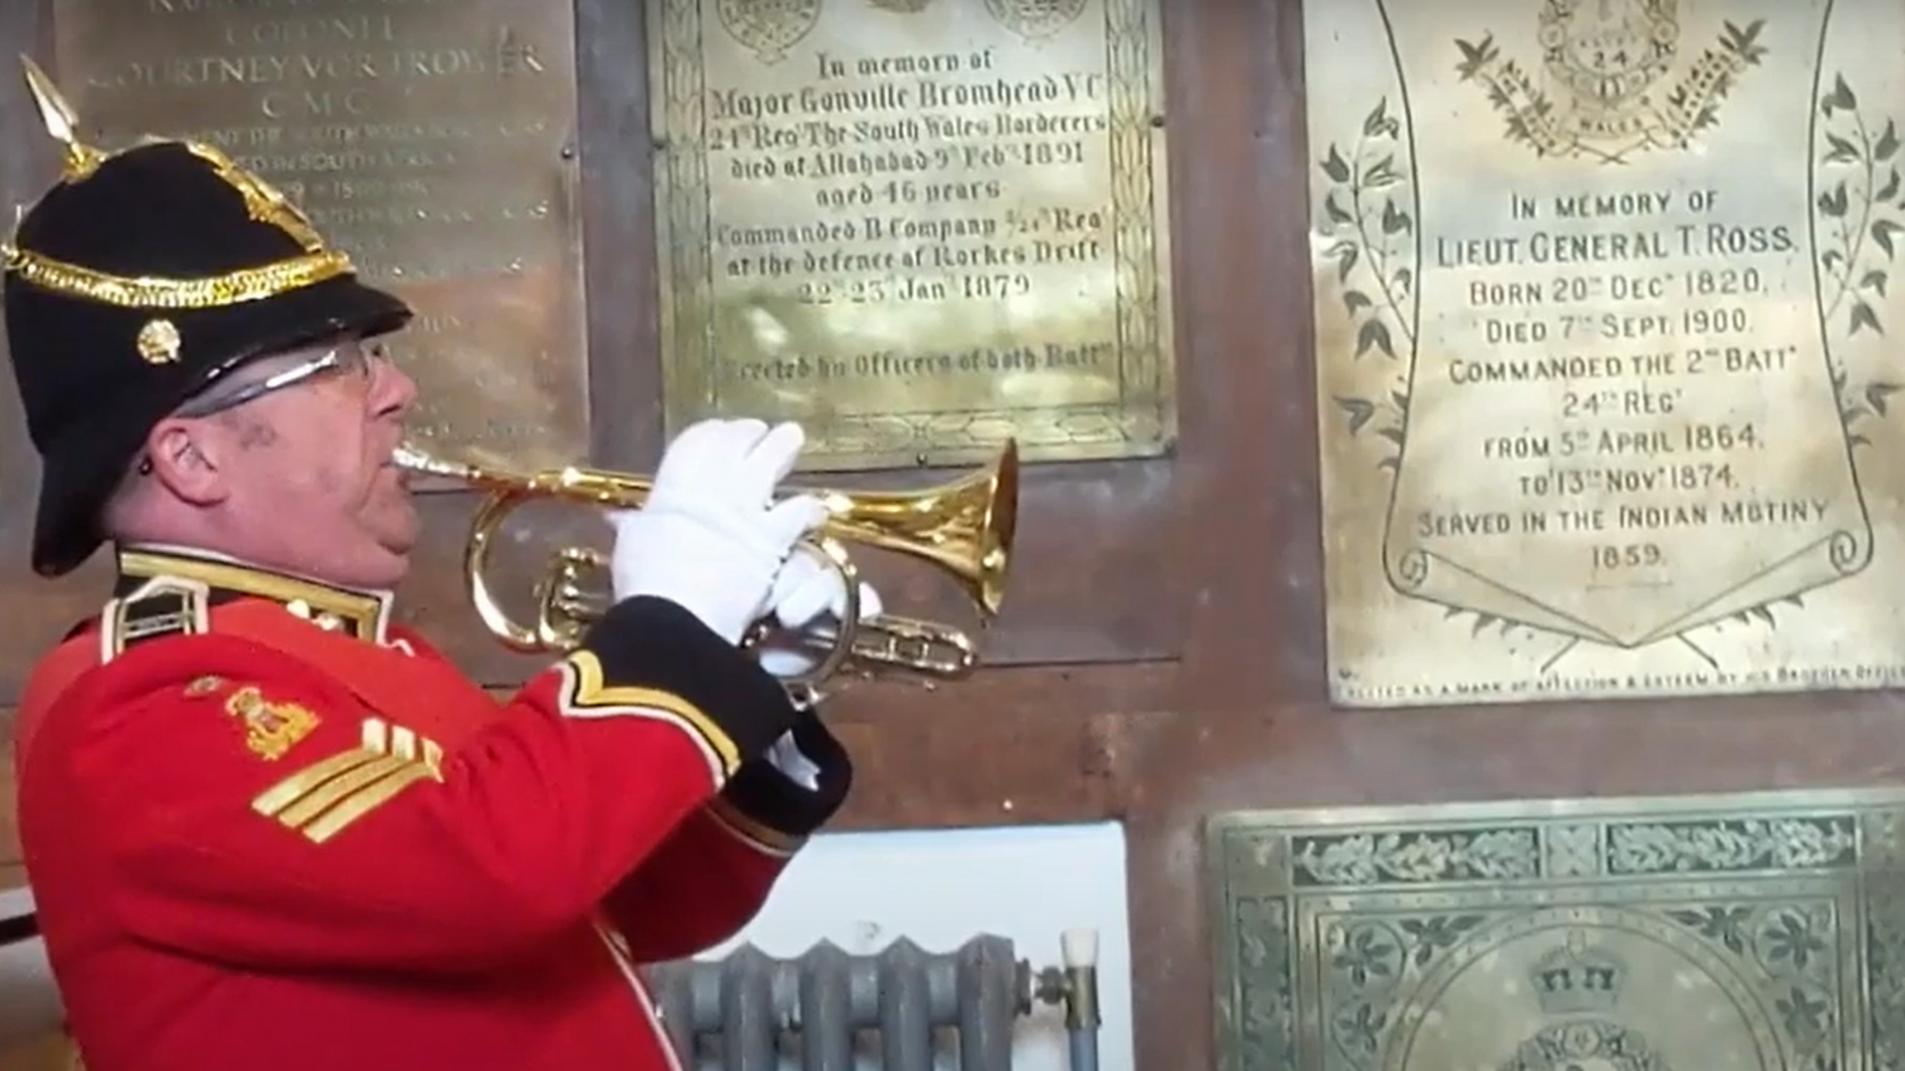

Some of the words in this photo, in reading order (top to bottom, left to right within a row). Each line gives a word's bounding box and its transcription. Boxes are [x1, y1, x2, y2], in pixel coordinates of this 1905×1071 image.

[816, 51, 845, 80] In
[857, 52, 960, 76] memory
[969, 48, 994, 70] of
[709, 87, 795, 121] Major
[799, 82, 910, 114] Gonville
[918, 75, 1059, 108] Bromhead
[804, 120, 848, 149] The
[853, 118, 920, 145] South
[923, 114, 990, 139] Wales
[995, 112, 1107, 136] Borderers
[730, 155, 777, 180] died
[783, 156, 805, 180] at
[808, 150, 929, 177] Allahabad
[1024, 141, 1084, 166] 1891
[815, 181, 874, 207] aged
[882, 180, 917, 205] 46
[925, 179, 1001, 203] years
[1511, 192, 1537, 220] IN
[1554, 190, 1672, 218] MEMORY
[1687, 189, 1720, 213] OF
[716, 220, 856, 247] Commanded
[864, 217, 882, 241] B
[890, 216, 997, 242] Company
[727, 257, 750, 277] at
[759, 252, 794, 277] the
[803, 249, 894, 273] defence
[901, 246, 924, 269] of
[933, 244, 1027, 267] Rorkes
[1032, 239, 1099, 264] Drift
[1436, 235, 1524, 269] LIEUT.
[1529, 230, 1670, 264] GENERAL
[963, 273, 1031, 299] 1879
[1469, 280, 1544, 307] BORN
[1486, 318, 1548, 345] DIED
[854, 350, 952, 377] Officers
[959, 350, 981, 372] of
[986, 346, 1037, 372] both
[1449, 355, 1624, 386] COMMANDED
[1631, 353, 1677, 377] THE
[1483, 436, 1551, 460] FROM
[1596, 427, 1676, 456] APRIL
[1519, 474, 1550, 497] TO
[1417, 510, 1512, 539] SERVED
[1521, 510, 1547, 535] IN
[1558, 510, 1605, 532] THE
[1618, 502, 1709, 530] INDIAN
[1720, 497, 1829, 525] MUTINY
